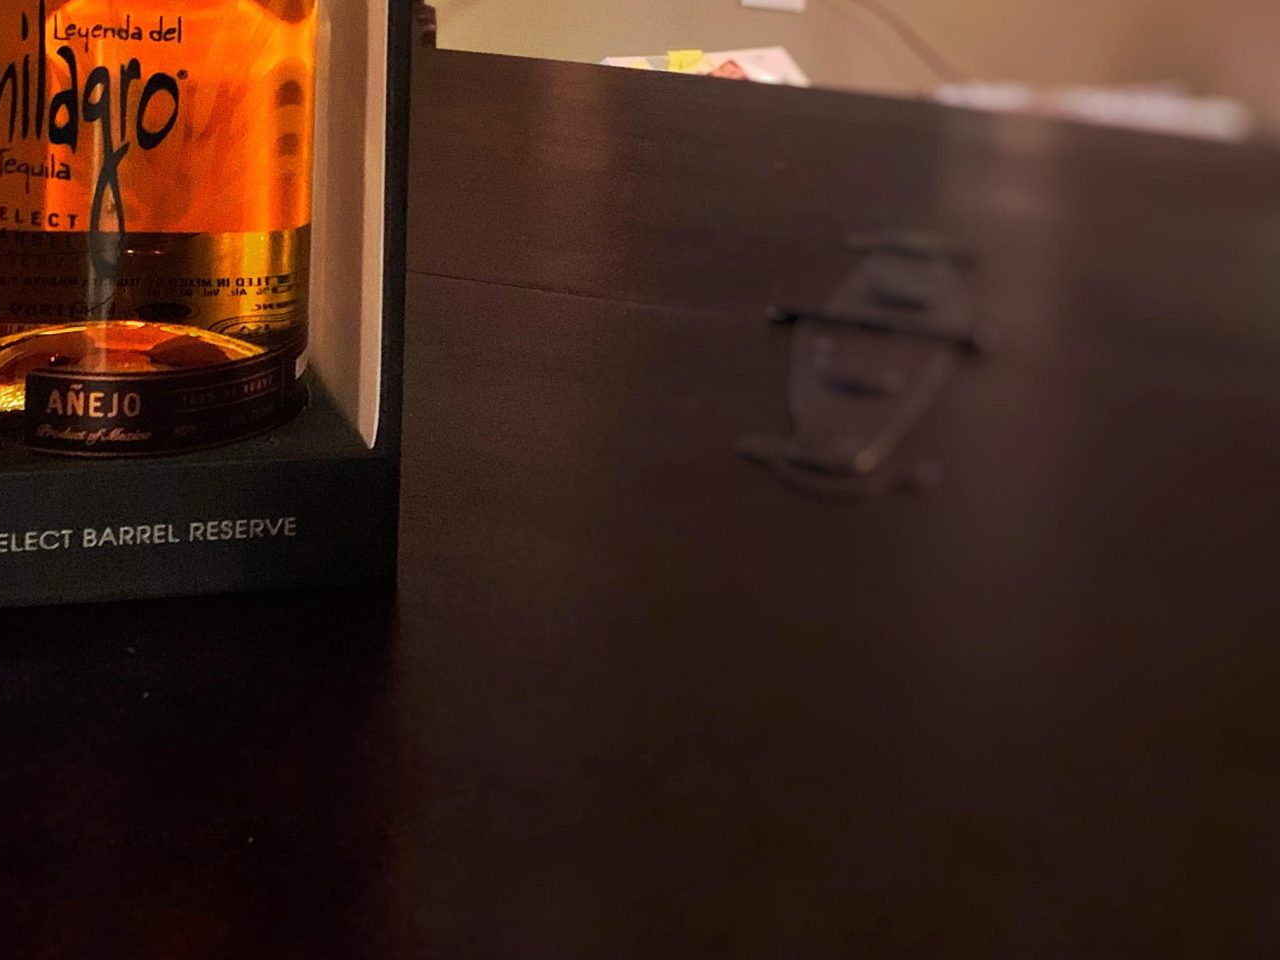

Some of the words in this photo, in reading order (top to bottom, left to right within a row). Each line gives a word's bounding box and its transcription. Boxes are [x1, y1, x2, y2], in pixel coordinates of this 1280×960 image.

[53, 14, 143, 52] Leyenda
[148, 14, 183, 43] del
[44, 383, 142, 419] AÑEJO
[82, 523, 180, 548] BARREL
[188, 516, 297, 542] RESERVE
